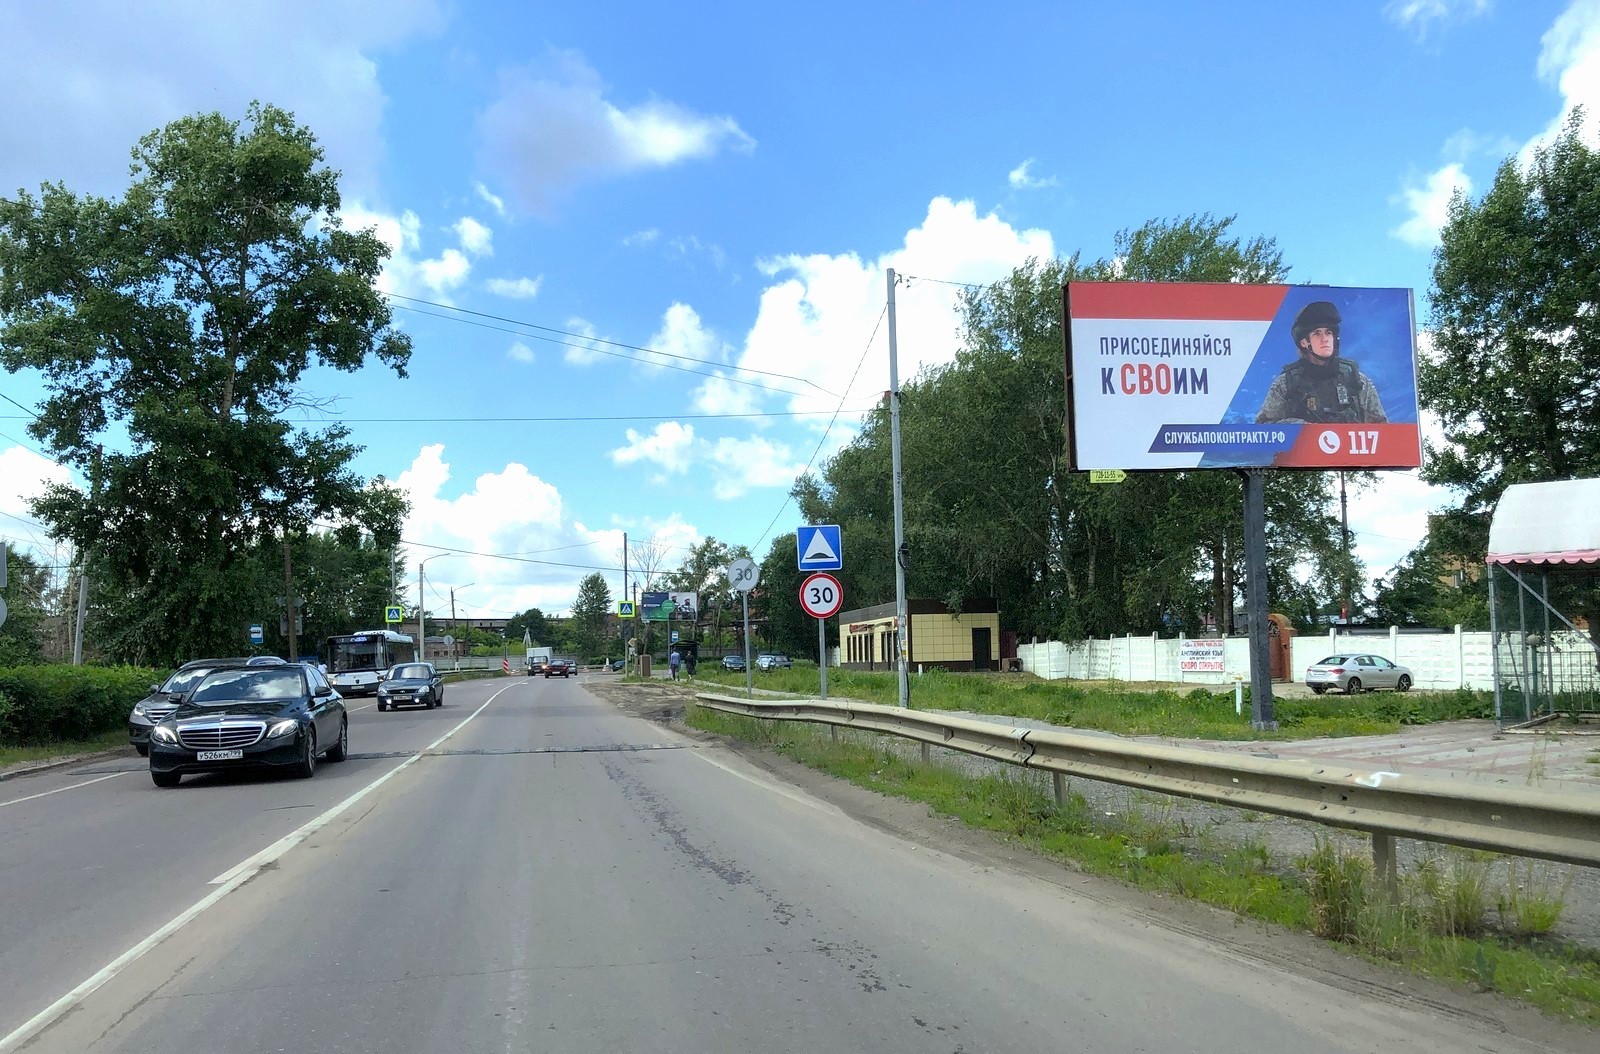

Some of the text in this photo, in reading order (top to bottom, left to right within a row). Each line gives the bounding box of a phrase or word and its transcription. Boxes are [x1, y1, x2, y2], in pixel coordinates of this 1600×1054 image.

[1100, 334, 1231, 358] ПРИСОЕДИНЯЙСЯ
[1101, 363, 1209, 395] К СВОИМ
[1164, 431, 1286, 445] СЛУЖБАПОКОНТРАКТУ.РФ
[1348, 431, 1379, 455] 117
[735, 568, 753, 581] 30
[810, 587, 834, 605] 30
[1181, 661, 1198, 670] СКОРО
